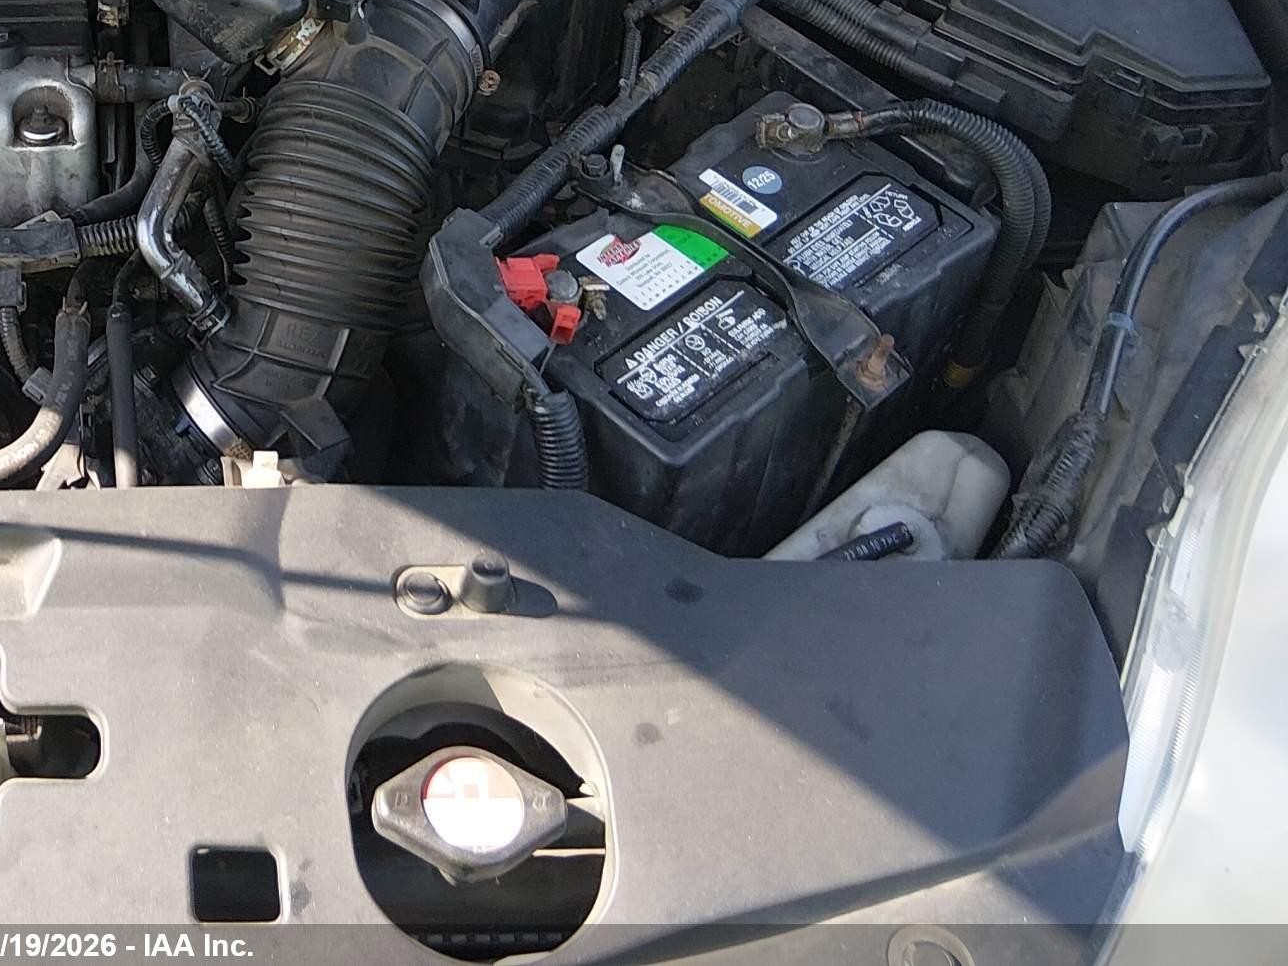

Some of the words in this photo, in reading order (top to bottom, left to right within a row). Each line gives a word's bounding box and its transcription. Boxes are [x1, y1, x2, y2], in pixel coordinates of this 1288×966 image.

[747, 170, 776, 190] 12/25
[705, 194, 750, 228] TOMOTIVE
[633, 328, 680, 363] DANGER
